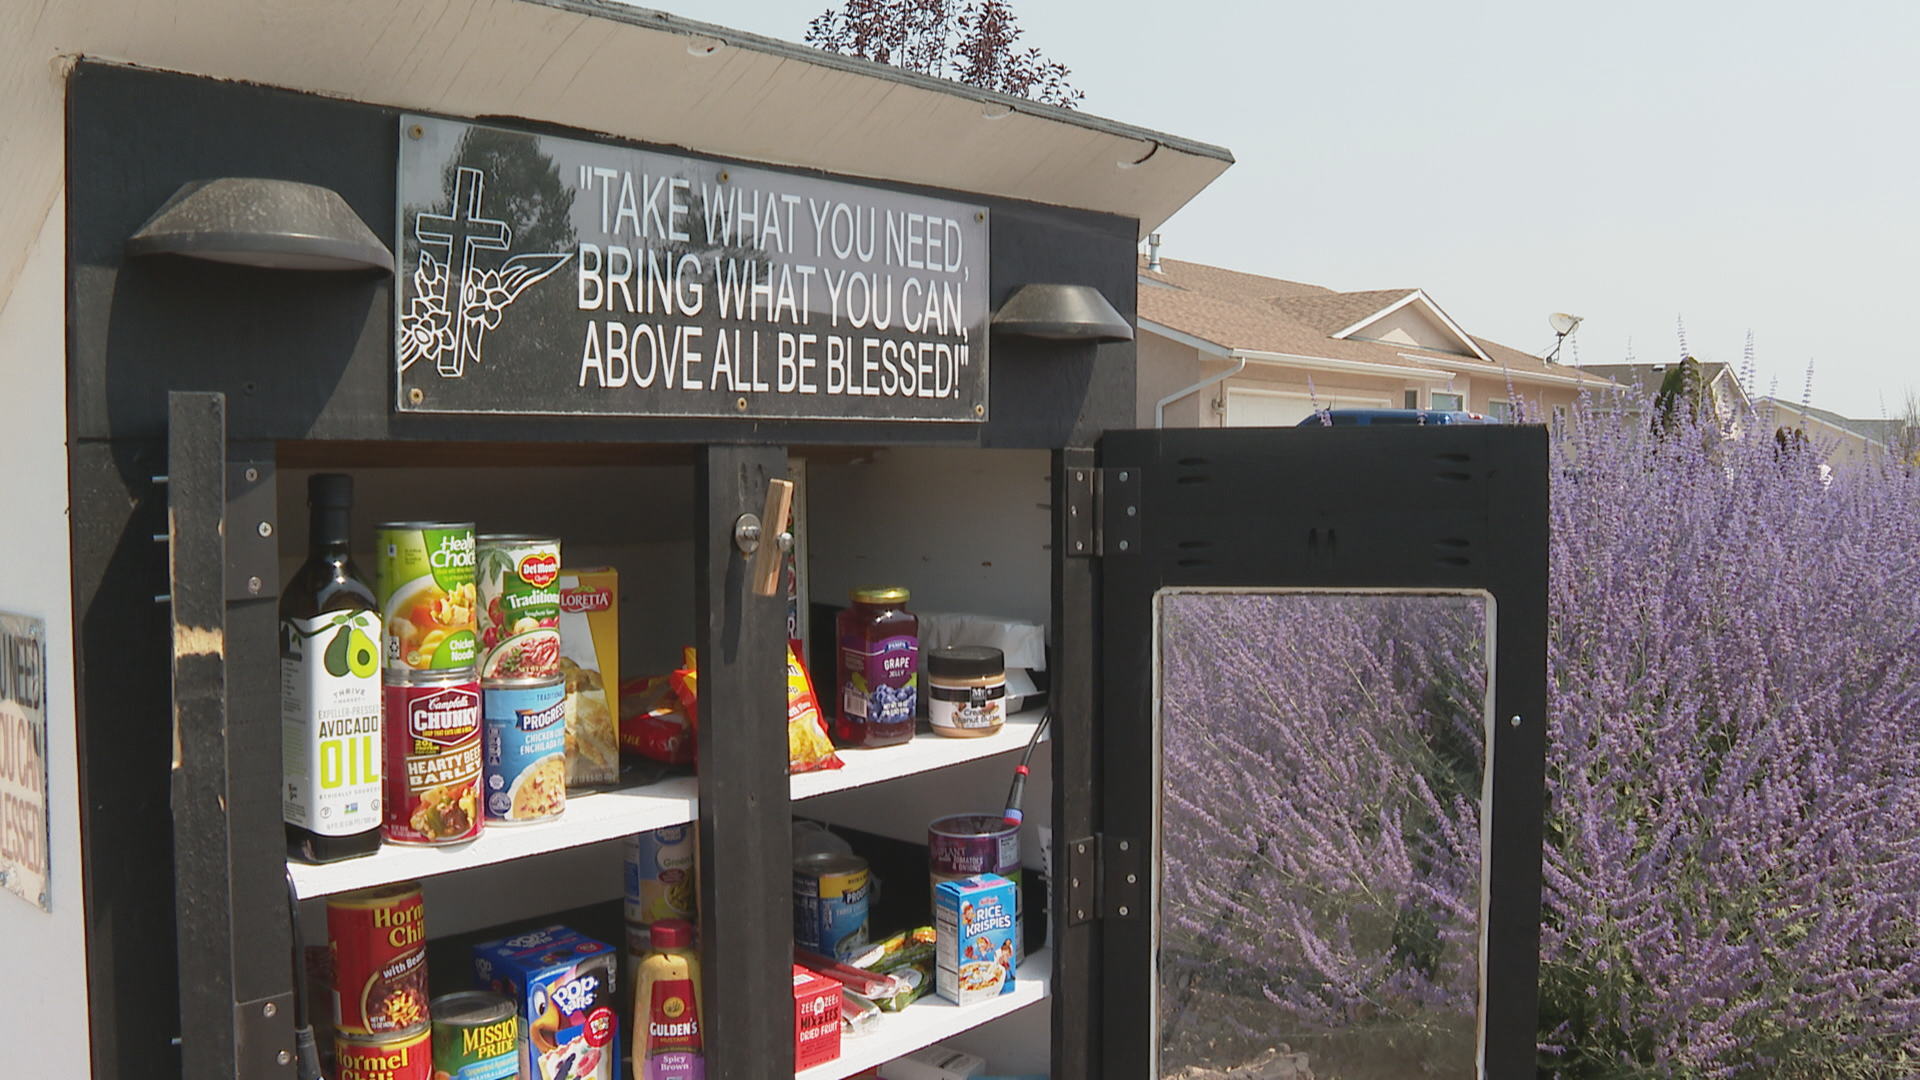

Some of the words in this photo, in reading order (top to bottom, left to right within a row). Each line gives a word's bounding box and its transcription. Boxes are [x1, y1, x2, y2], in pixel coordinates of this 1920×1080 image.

[579, 165, 690, 242] "TAKE
[702, 182, 801, 254] WHAT
[809, 197, 876, 263] YOU
[885, 209, 969, 282] NEED,
[578, 242, 703, 317] BRING
[714, 256, 816, 325] WHAT
[824, 267, 892, 330] YOU
[902, 277, 968, 343] CAN,
[578, 320, 703, 390] ABOVE
[710, 328, 770, 392] ALL
[777, 332, 818, 394] BE
[826, 335, 969, 399] BLESSED!"
[560, 591, 609, 607] LORETTA
[883, 656, 911, 671] GRAPE
[888, 669, 905, 678] JELLY
[333, 687, 366, 699] THRIVE
[318, 704, 380, 720] EXPELLER-PRESSED
[413, 705, 478, 731] CHUNKY
[318, 715, 379, 739] AVOCADO
[525, 730, 554, 745] CHICKEN
[320, 735, 379, 790] OIL
[407, 753, 463, 776] HEARTY
[463, 744, 482, 764] BEEF
[409, 758, 482, 786] BARLEY
[319, 789, 353, 800] ETHICALLY
[663, 856, 690, 867] Green
[953, 855, 984, 865] TOMATOES
[958, 864, 982, 872] ONIONS
[976, 904, 1003, 921] RICE
[966, 915, 1012, 938] KRISPIES
[382, 959, 407, 979] with
[801, 1001, 814, 1014] ZEE
[462, 1014, 518, 1057] MISSION
[649, 1017, 698, 1037] GULDEN'S
[799, 1027, 820, 1042] DRIED
[820, 1021, 838, 1036] FRUIT
[335, 1047, 409, 1071] Hormel
[477, 1039, 514, 1060] PRIDE
[662, 1055, 686, 1064] Spicy
[660, 1063, 689, 1071] Brown
